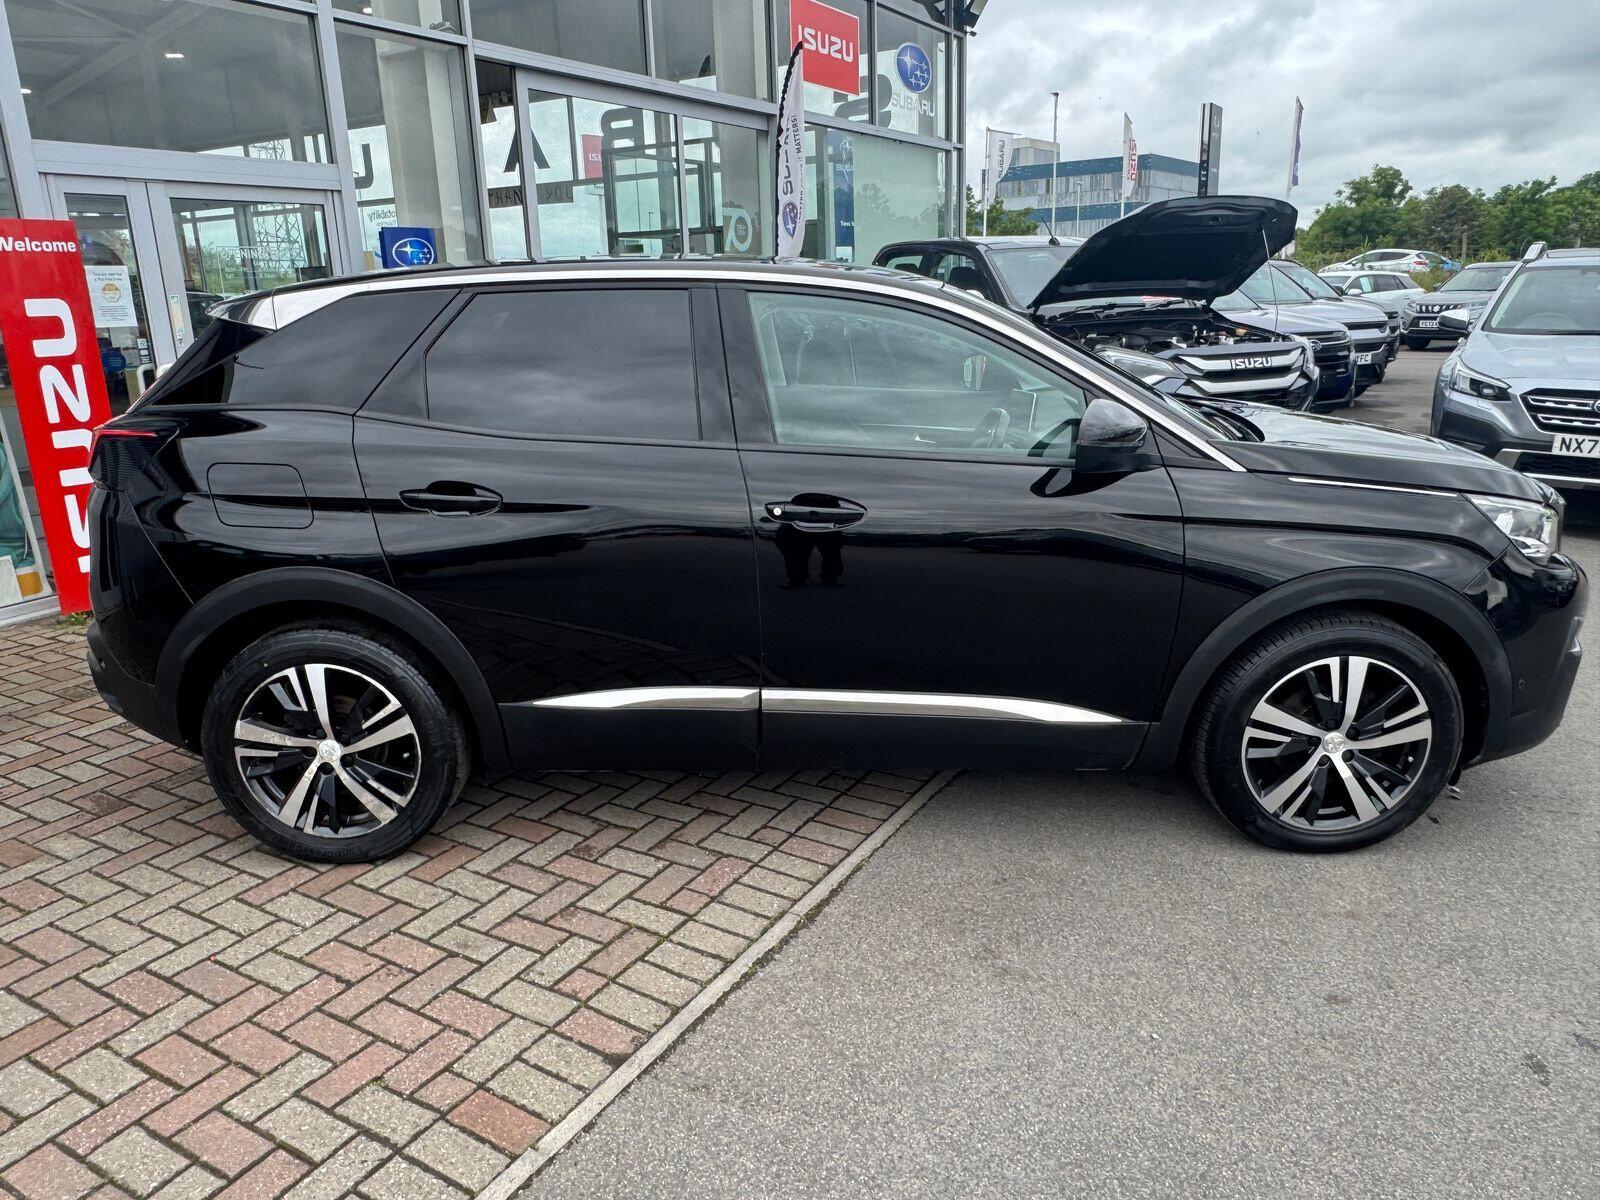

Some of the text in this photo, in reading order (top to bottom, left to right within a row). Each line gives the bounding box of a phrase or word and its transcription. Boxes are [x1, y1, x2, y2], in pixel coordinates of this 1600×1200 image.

[798, 24, 854, 63] ISUZU
[891, 93, 936, 118] SUBARU
[0, 237, 77, 253] Welcome
[1231, 357, 1272, 370] ISUZU
[25, 297, 95, 574] UZU
[1559, 436, 1600, 454] NX7
